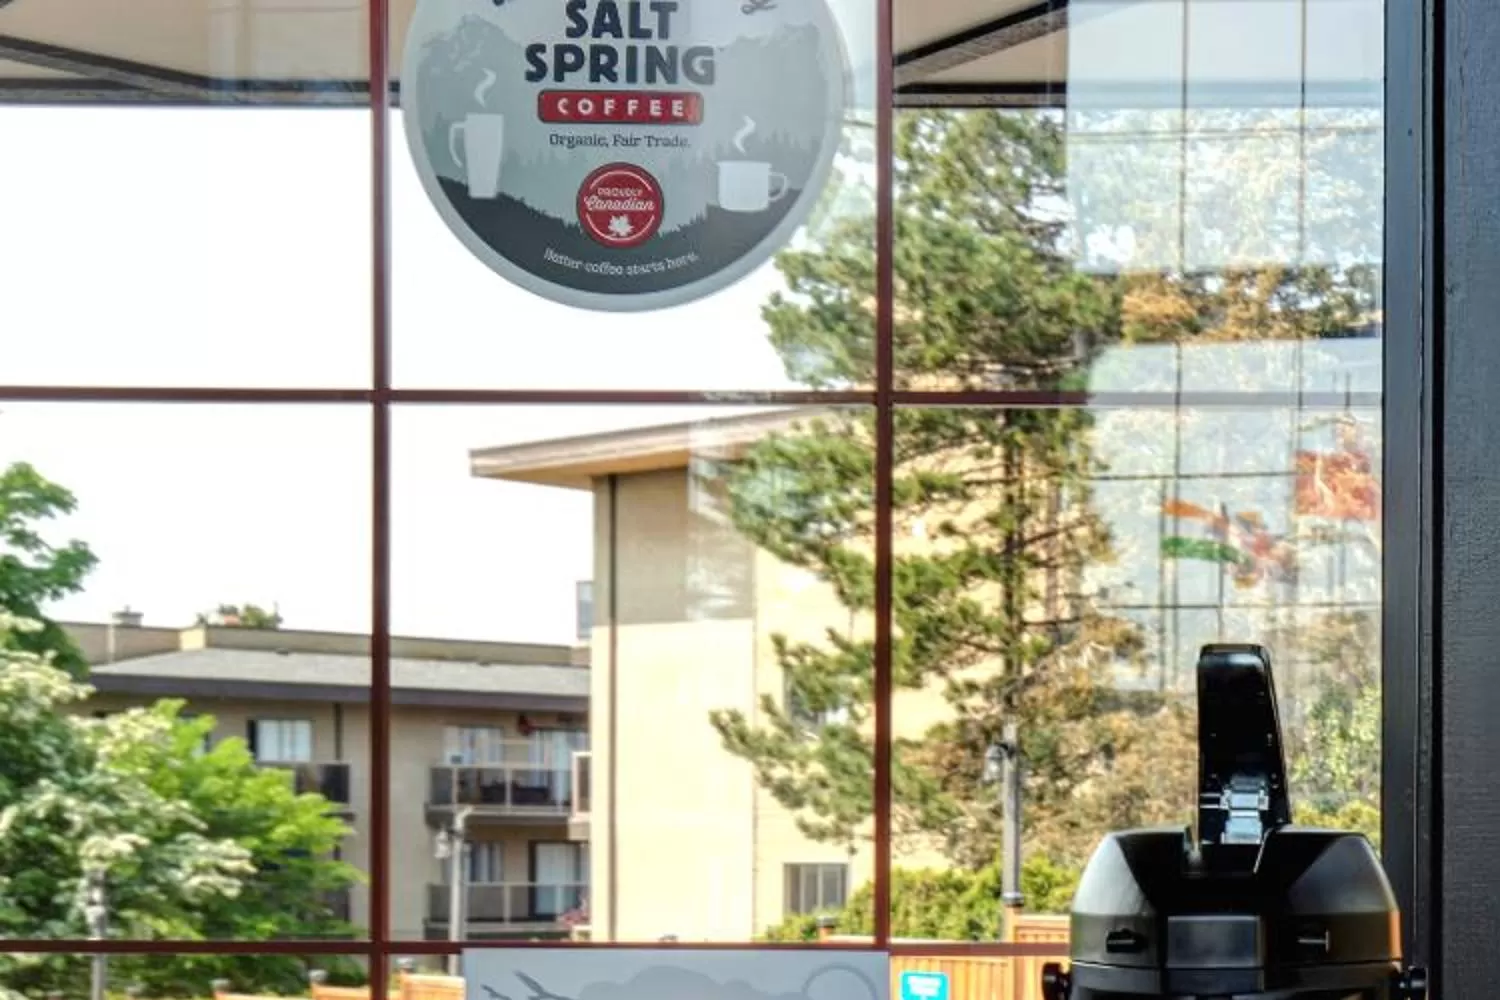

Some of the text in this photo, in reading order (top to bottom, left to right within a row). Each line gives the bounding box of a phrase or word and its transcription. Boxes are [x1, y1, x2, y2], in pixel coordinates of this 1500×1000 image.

[565, 1, 677, 40] SALT
[524, 44, 716, 86] SPRING
[557, 98, 684, 117] COFFEE
[549, 133, 609, 149] Organic,
[613, 133, 641, 147] Fair
[584, 195, 655, 211] Canadian
